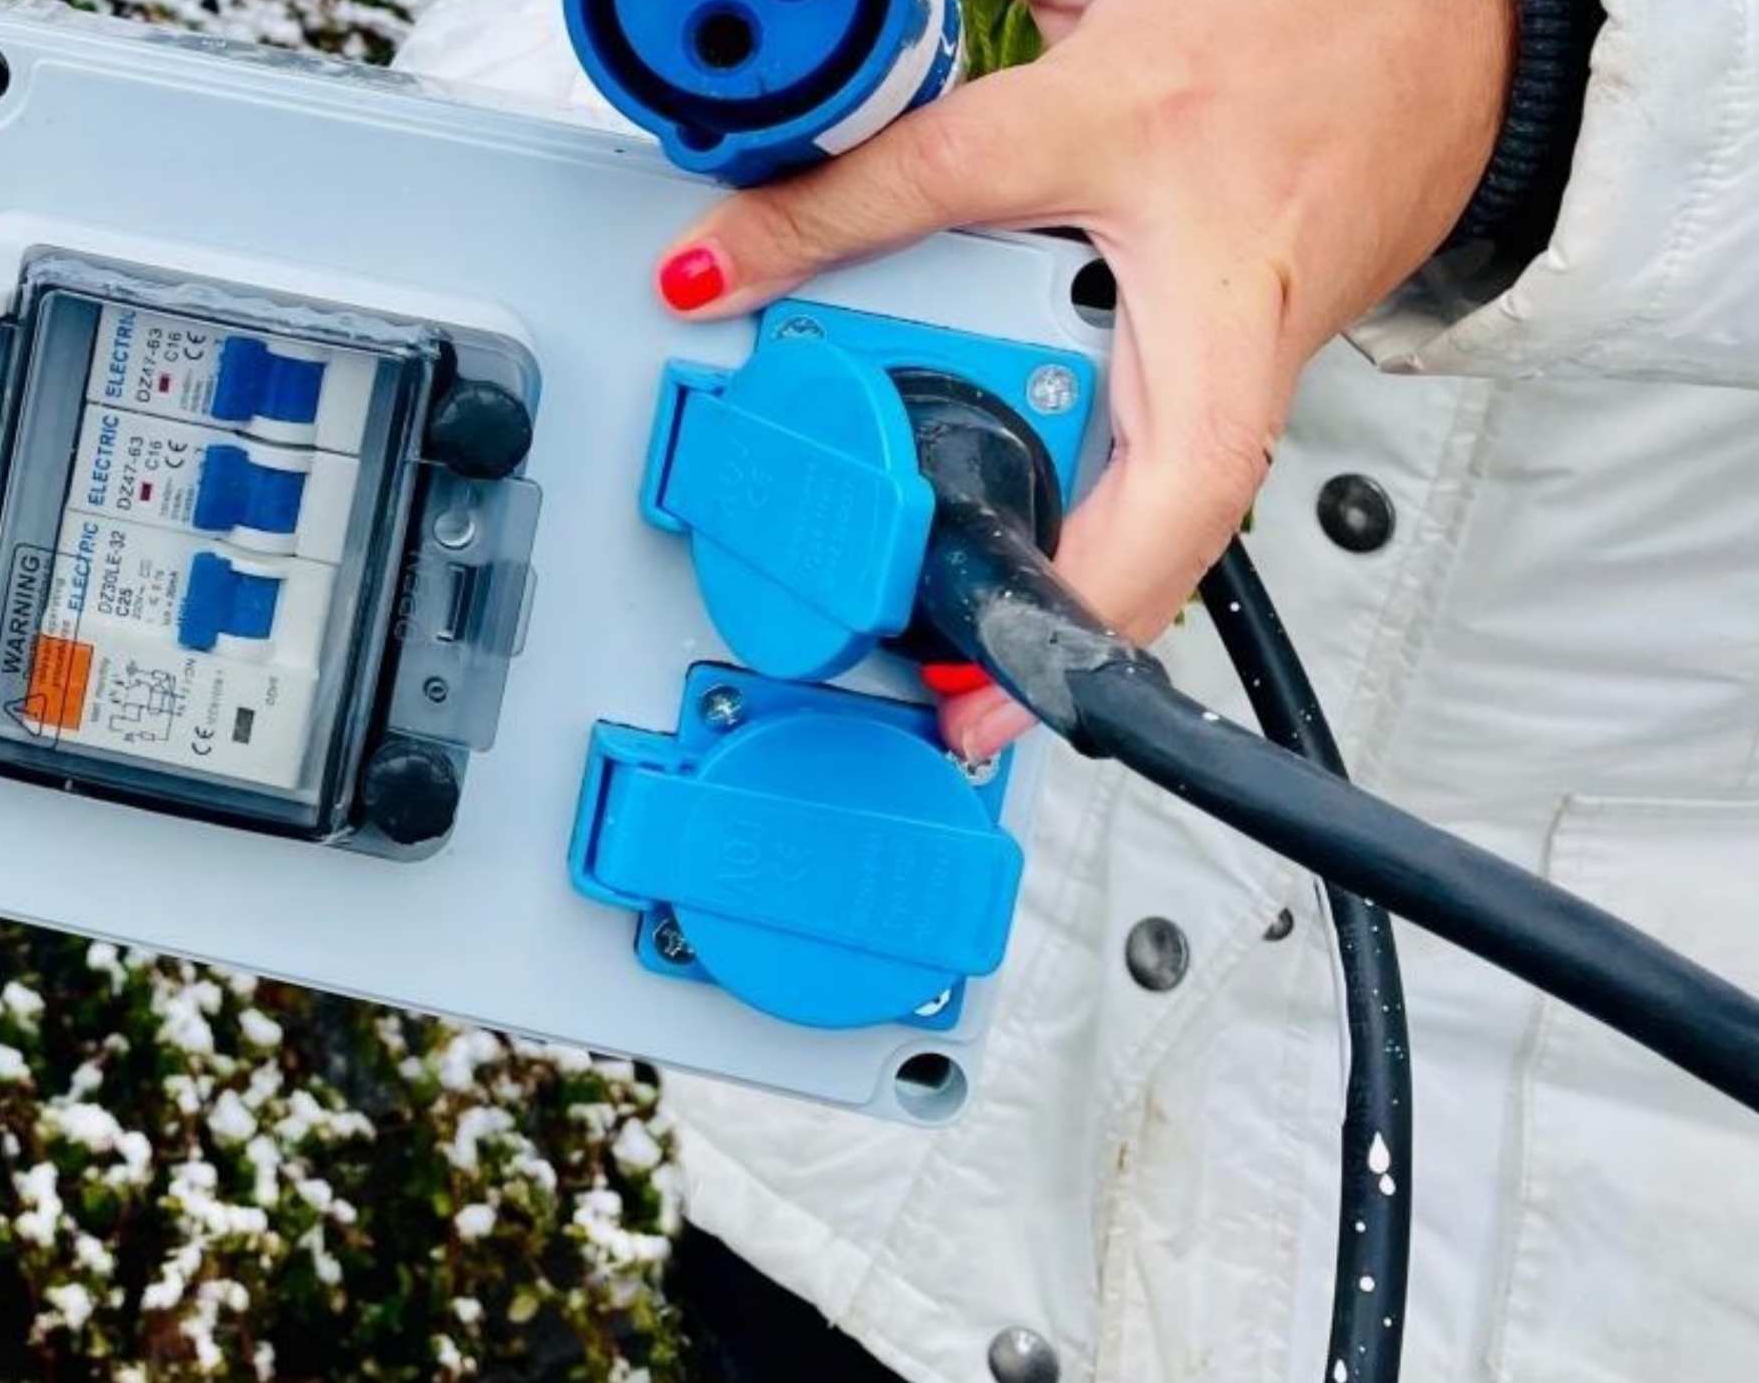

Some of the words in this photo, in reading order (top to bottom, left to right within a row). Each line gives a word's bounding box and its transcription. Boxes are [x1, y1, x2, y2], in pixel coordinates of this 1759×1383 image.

[136, 328, 163, 403] DZ47-63
[164, 332, 183, 362] C16
[88, 414, 120, 507] ELECTRIC
[116, 436, 144, 511] DZ47-63
[145, 441, 163, 471] C16
[68, 520, 100, 615] ELECTRIC
[116, 587, 134, 618] C25
[2, 554, 41, 675] WARNING
